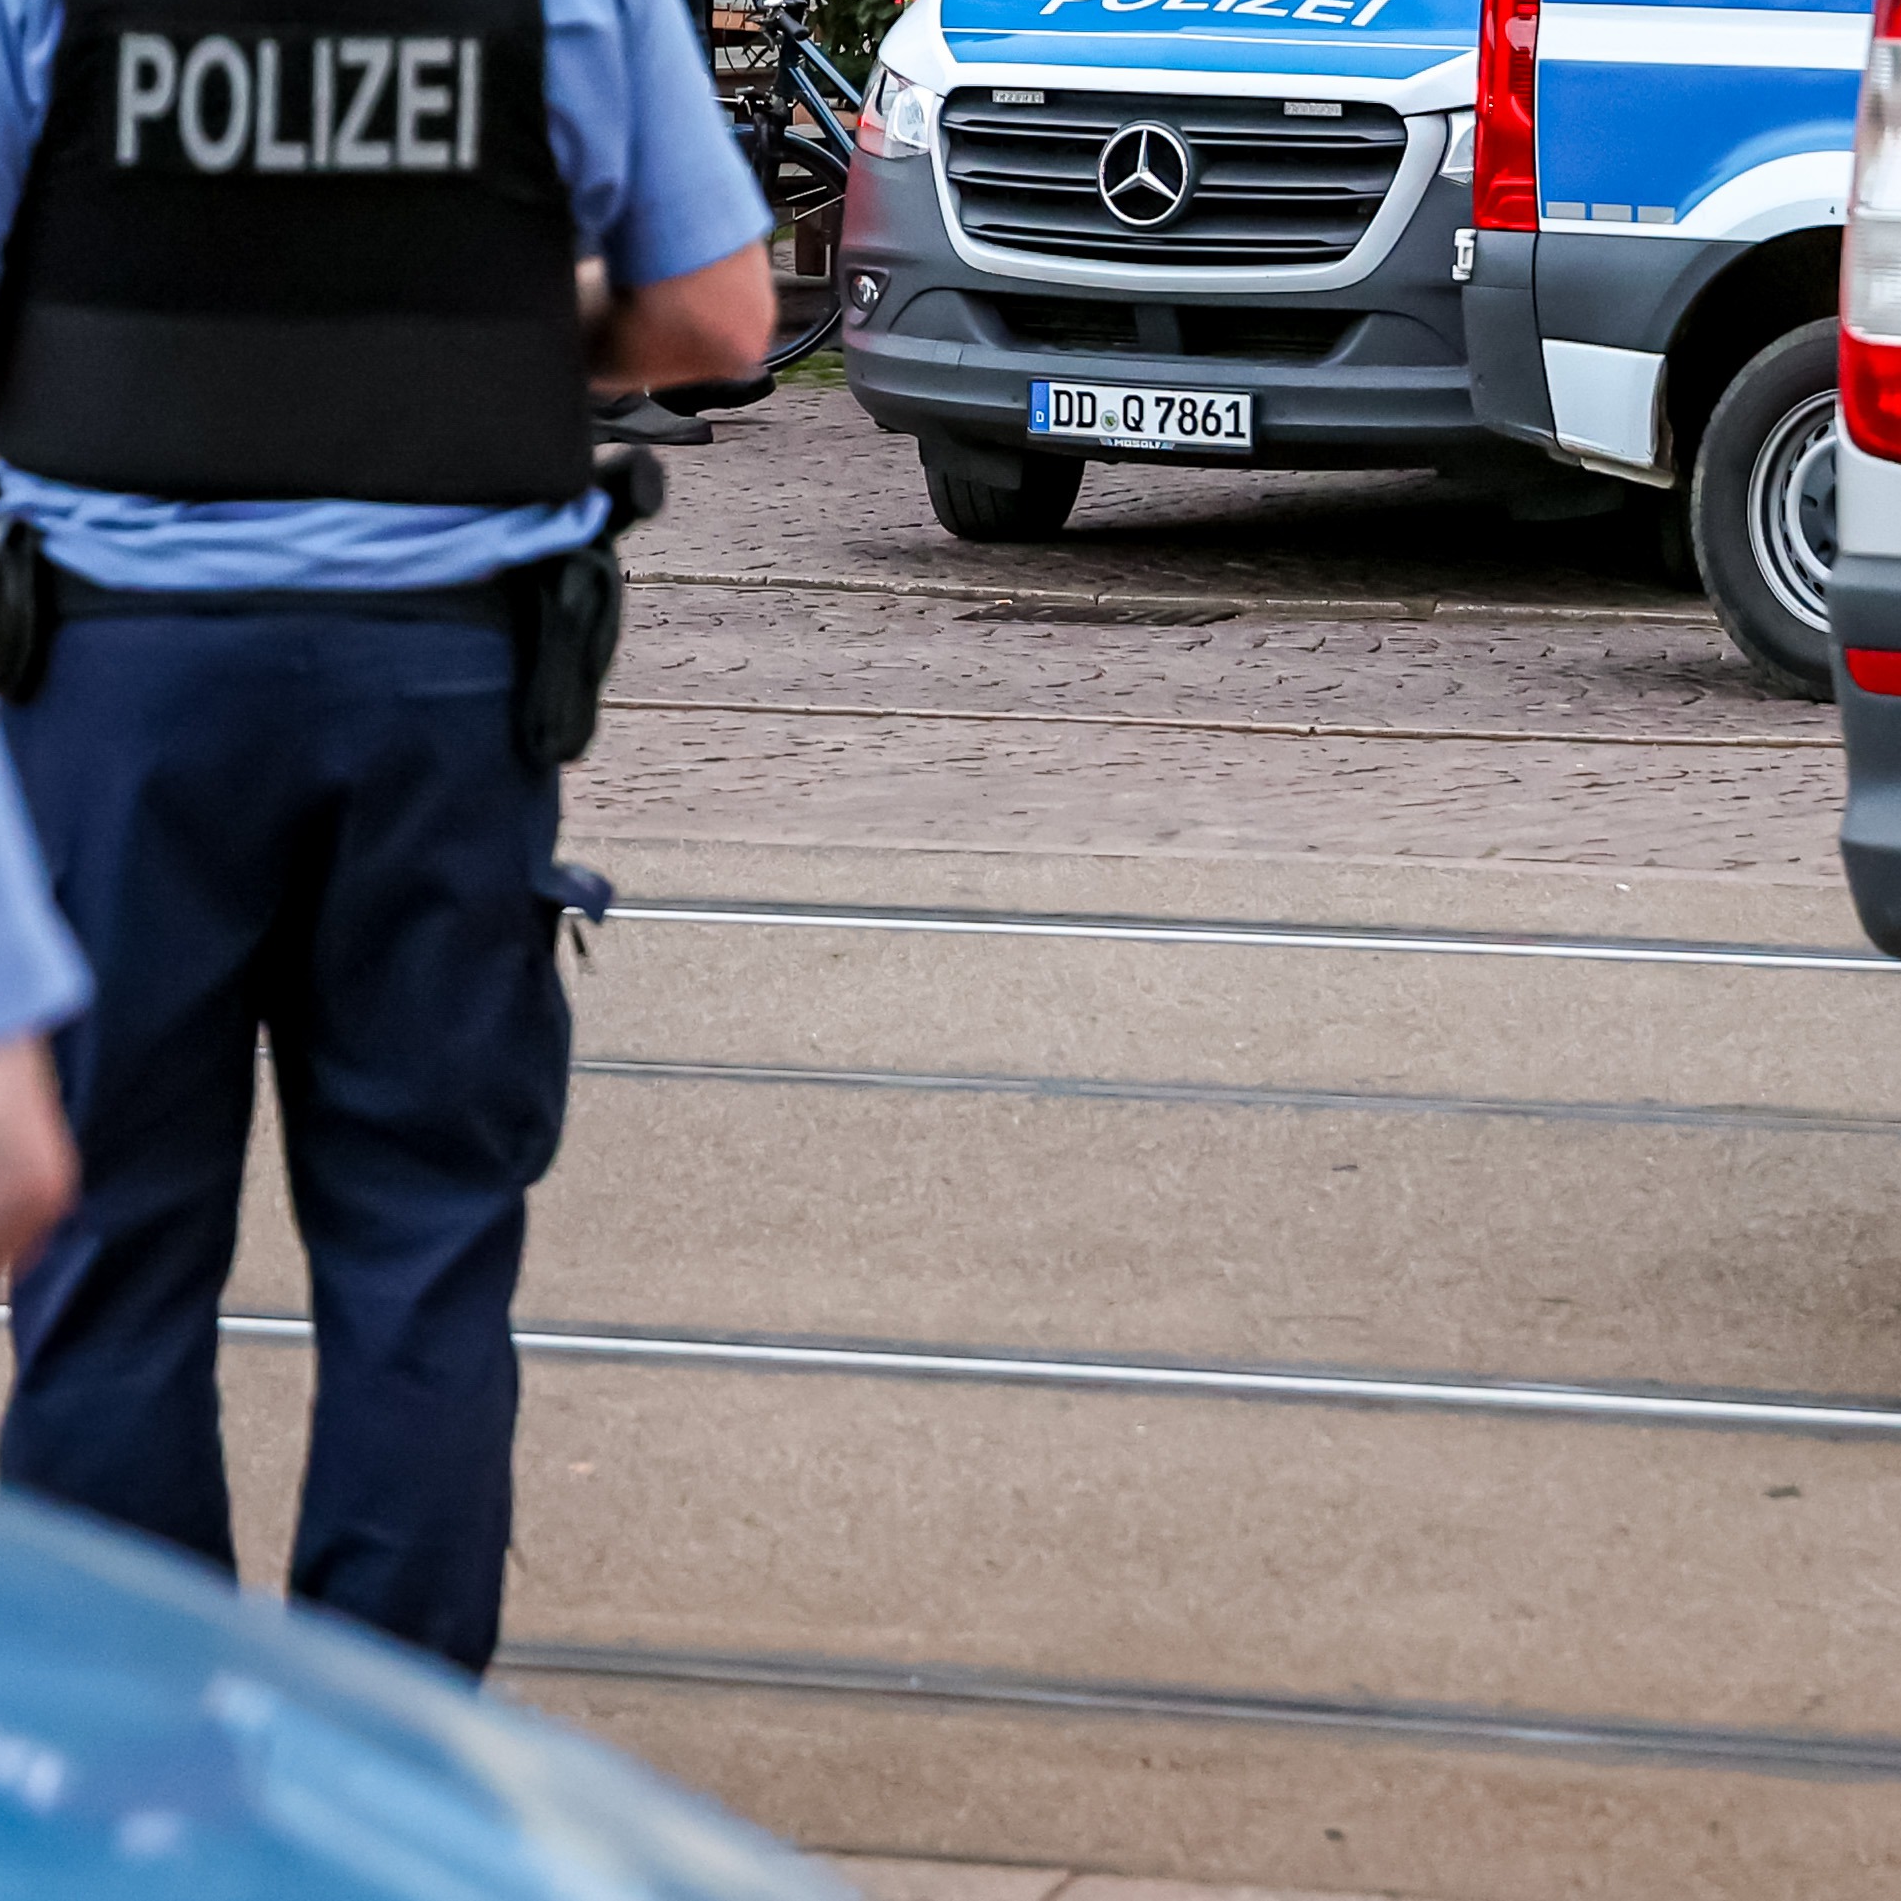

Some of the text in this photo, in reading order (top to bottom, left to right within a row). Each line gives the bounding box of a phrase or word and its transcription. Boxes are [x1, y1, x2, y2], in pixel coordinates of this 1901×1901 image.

[115, 32, 480, 173] POLIZEI
[1035, 410, 1044, 423] D
[1053, 389, 1246, 439] DD Q 7861
